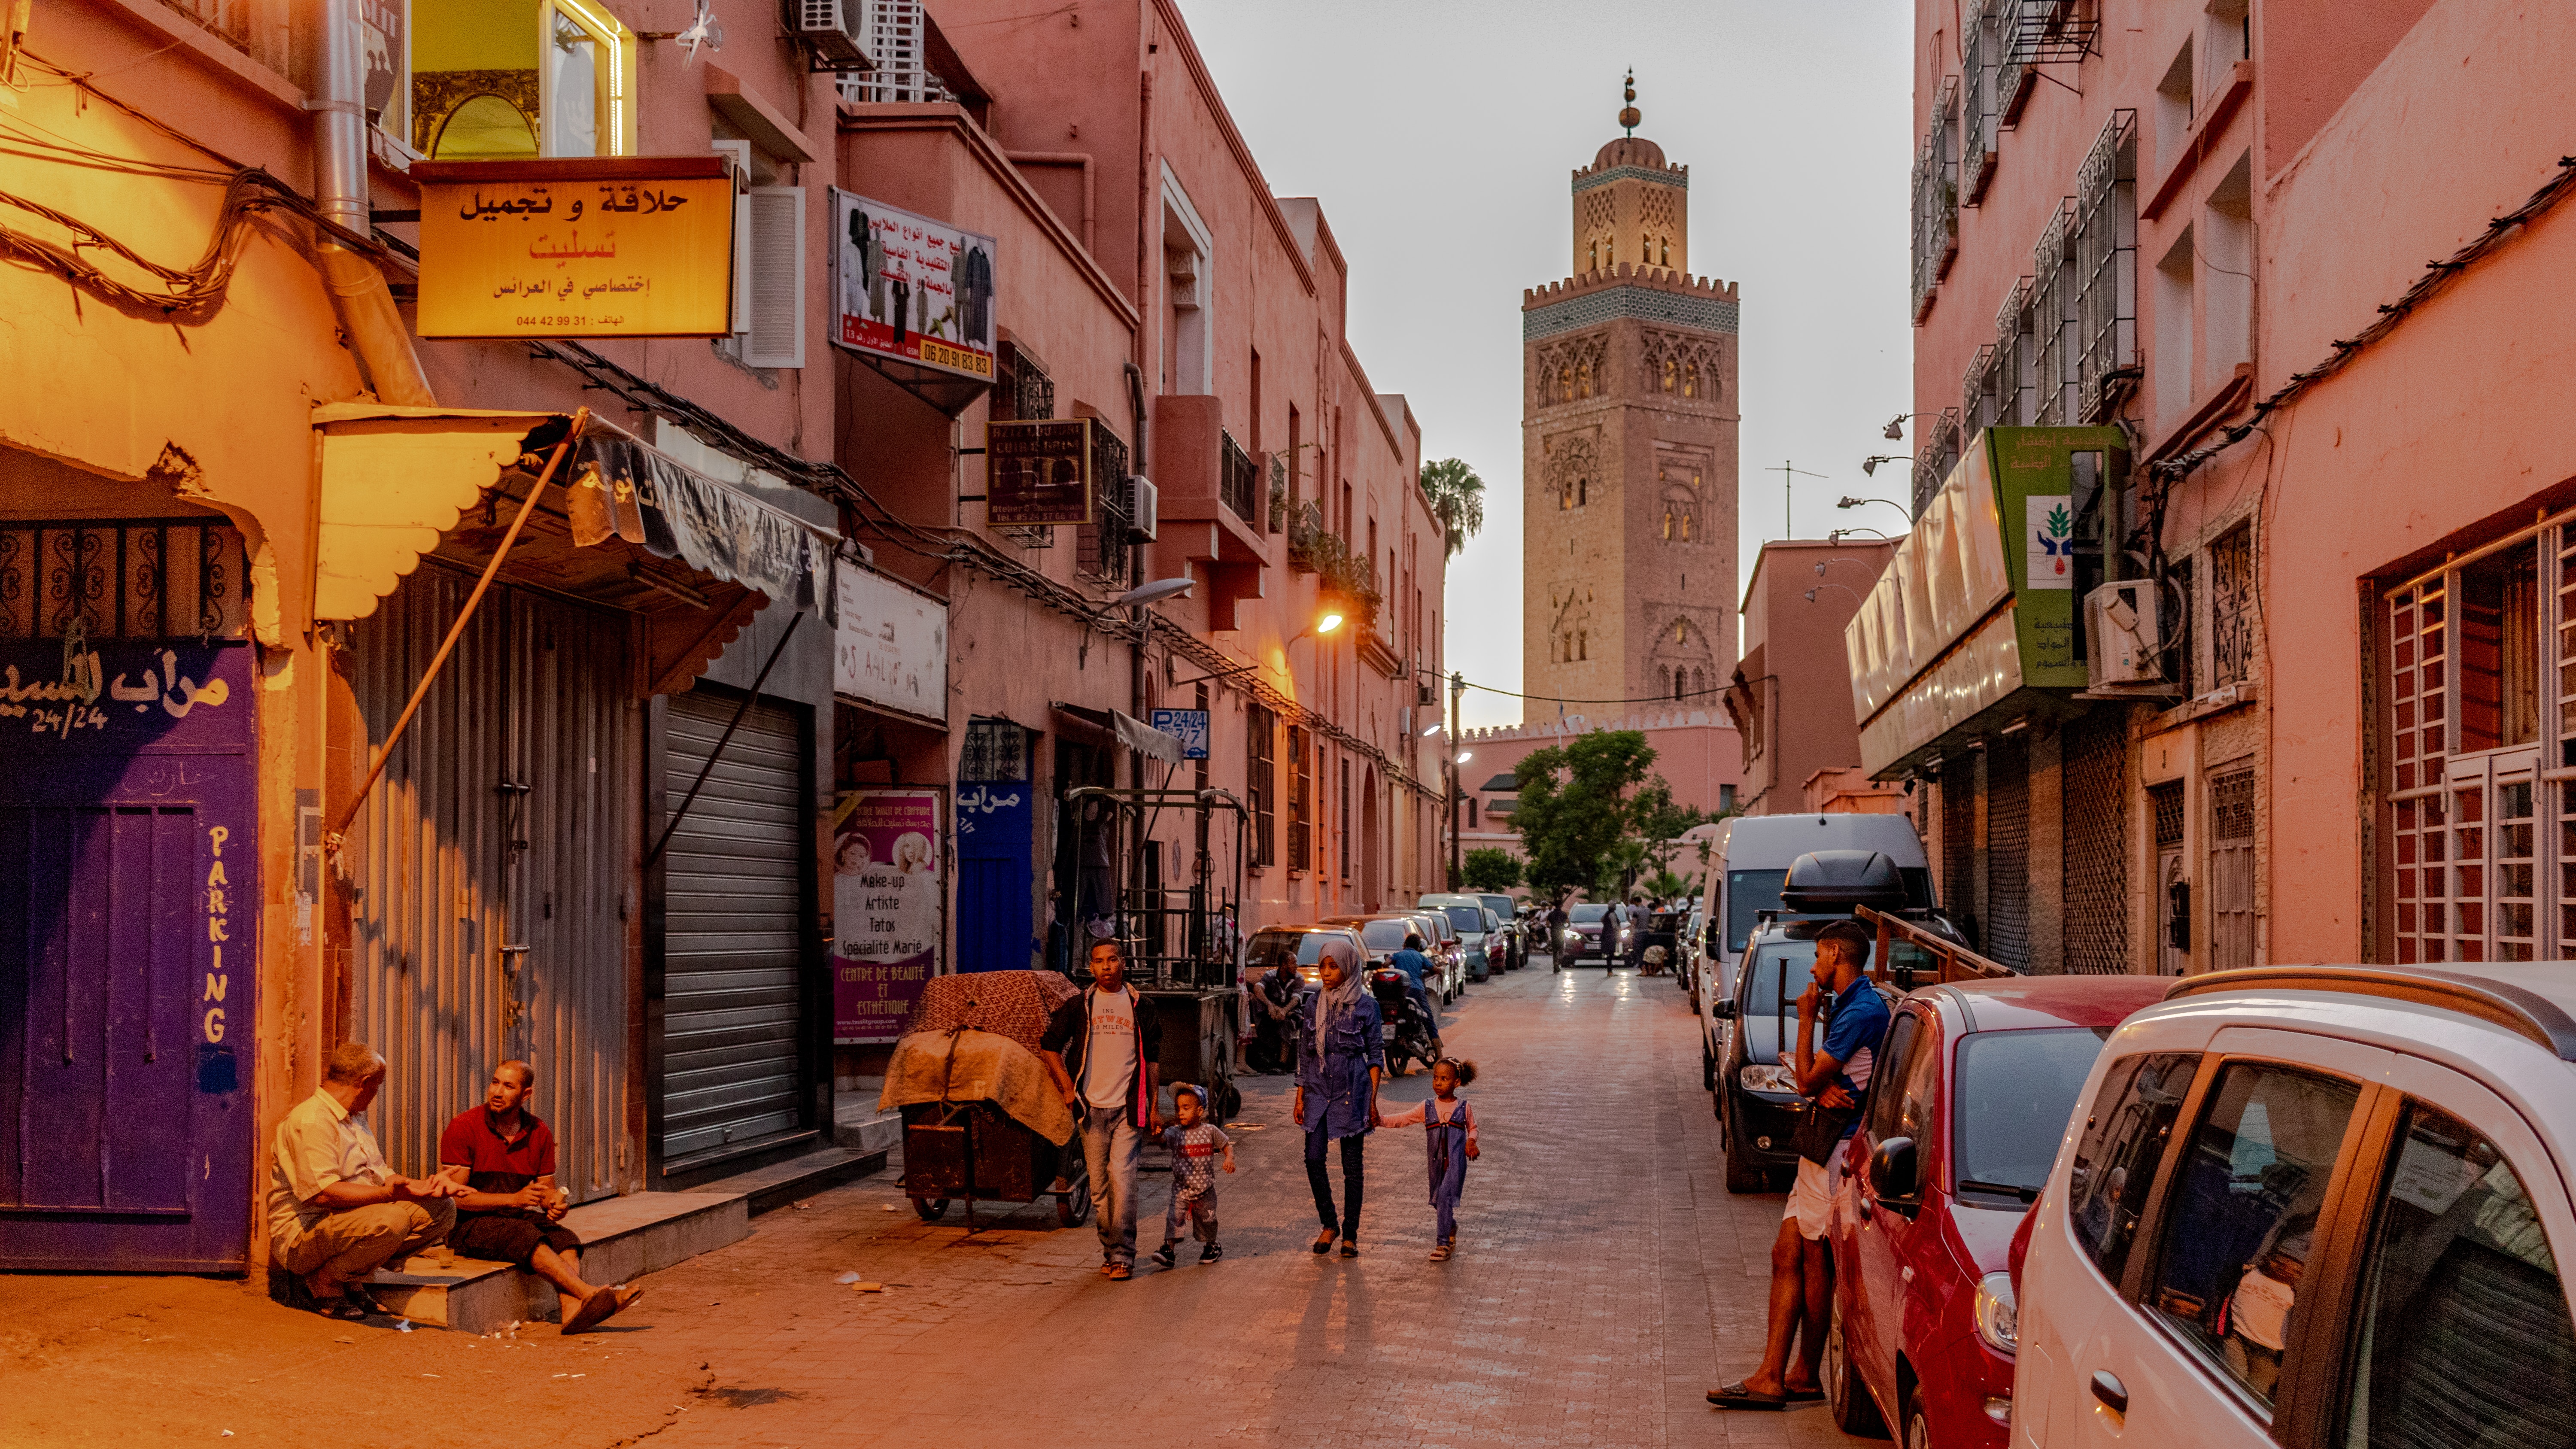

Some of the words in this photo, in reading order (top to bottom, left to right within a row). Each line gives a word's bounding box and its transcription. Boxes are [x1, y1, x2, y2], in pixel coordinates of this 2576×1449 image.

[460, 188, 552, 221] تجميل
[563, 195, 583, 222] و
[601, 186, 688, 215] حلاقة
[868, 218, 899, 232] الملابس
[903, 226, 923, 242] أنواع
[927, 235, 944, 250] جميع
[529, 228, 616, 268] تسليت
[916, 250, 949, 271] التقليدية
[493, 277, 551, 299] العرائس
[557, 276, 574, 302] في
[583, 276, 650, 299] إختصاصي
[925, 275, 952, 300] بالجملة
[516, 316, 537, 327] 044
[540, 316, 553, 327] 42
[557, 316, 570, 326] 99
[573, 316, 586, 326] 31
[598, 315, 625, 326] الهاتف
[846, 329, 855, 339] 13
[906, 346, 919, 356] GSM
[925, 344, 936, 361] 06
[939, 347, 949, 364] 20
[951, 352, 960, 367] 91
[962, 354, 973, 371] 83
[975, 357, 987, 374] 83
[32, 703, 108, 740] 24/24
[1154, 711, 1173, 730] P
[1174, 712, 1206, 730] 24/24
[1176, 728, 1200, 744] 7/7
[860, 873, 905, 890] Make-up
[865, 896, 900, 911] Artiste
[869, 917, 896, 933] Tatos
[204, 826, 230, 1044] PARKING
[842, 940, 889, 959] Spécialité
[840, 966, 873, 982] CENTRE
[876, 967, 889, 981] DE
[890, 964, 925, 981] BEAUTÉ
[877, 983, 889, 998] ET
[857, 998, 909, 1015] ESTHÉTIQUE
[1092, 1015, 1134, 1030] NTWER
